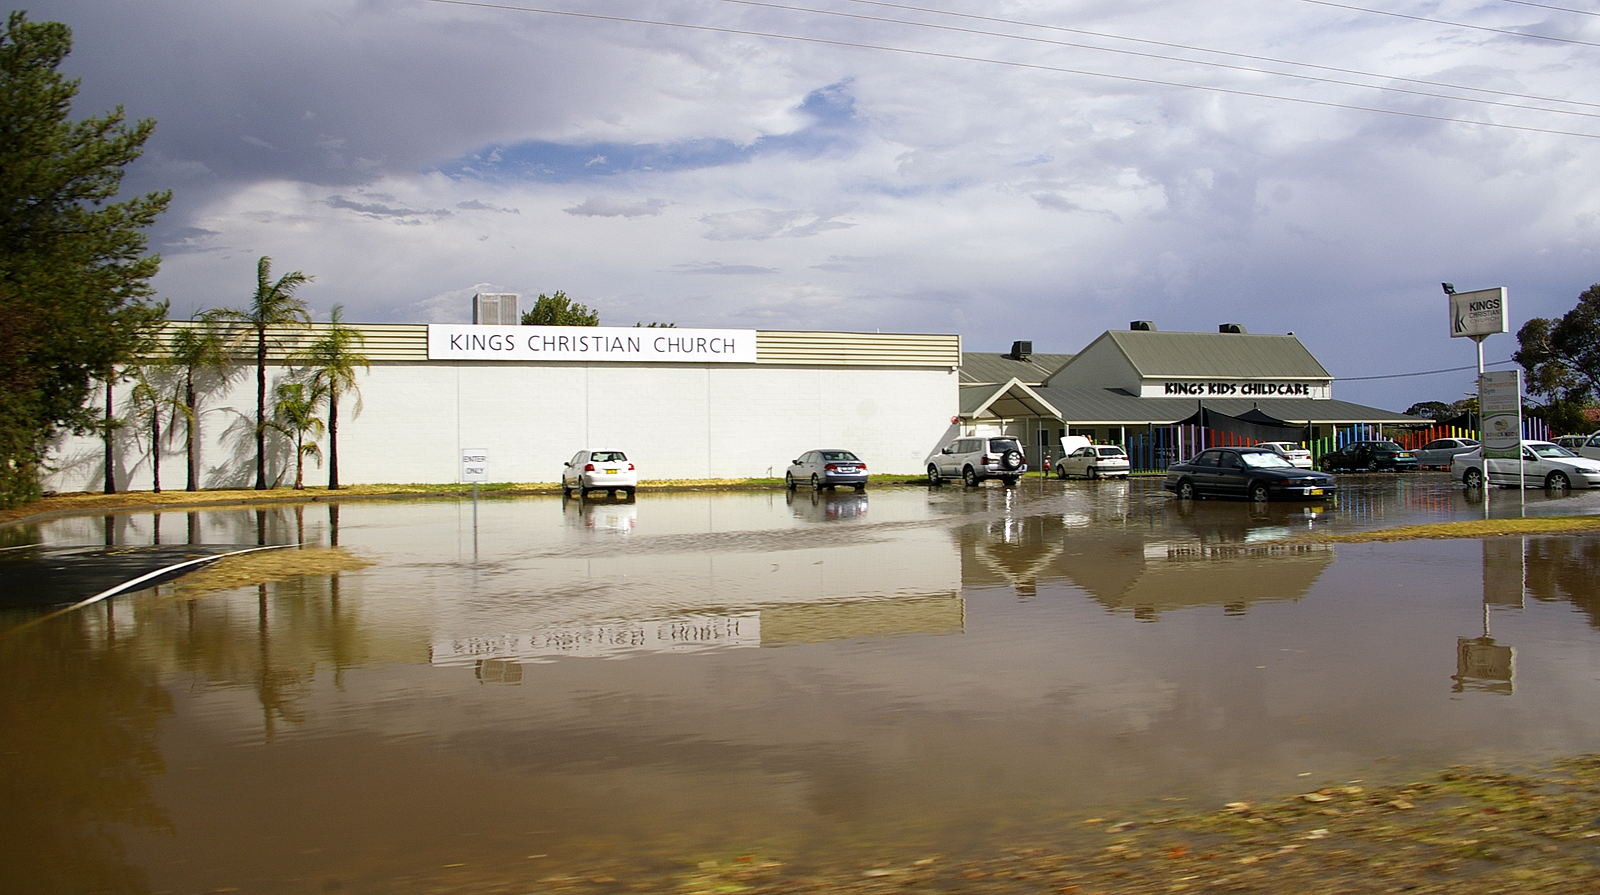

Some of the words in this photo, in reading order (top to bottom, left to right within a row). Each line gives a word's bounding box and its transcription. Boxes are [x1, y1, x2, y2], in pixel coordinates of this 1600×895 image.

[1469, 299, 1500, 311] KINGS
[1469, 309, 1500, 318] CHRISTIAN
[450, 334, 515, 351] KINGS
[527, 335, 641, 352] CHRISTIAN
[653, 337, 735, 353] CHURCH
[1164, 382, 1205, 395] KINGS
[1208, 382, 1237, 395] KIDS
[1240, 383, 1310, 395] CHILDCARE
